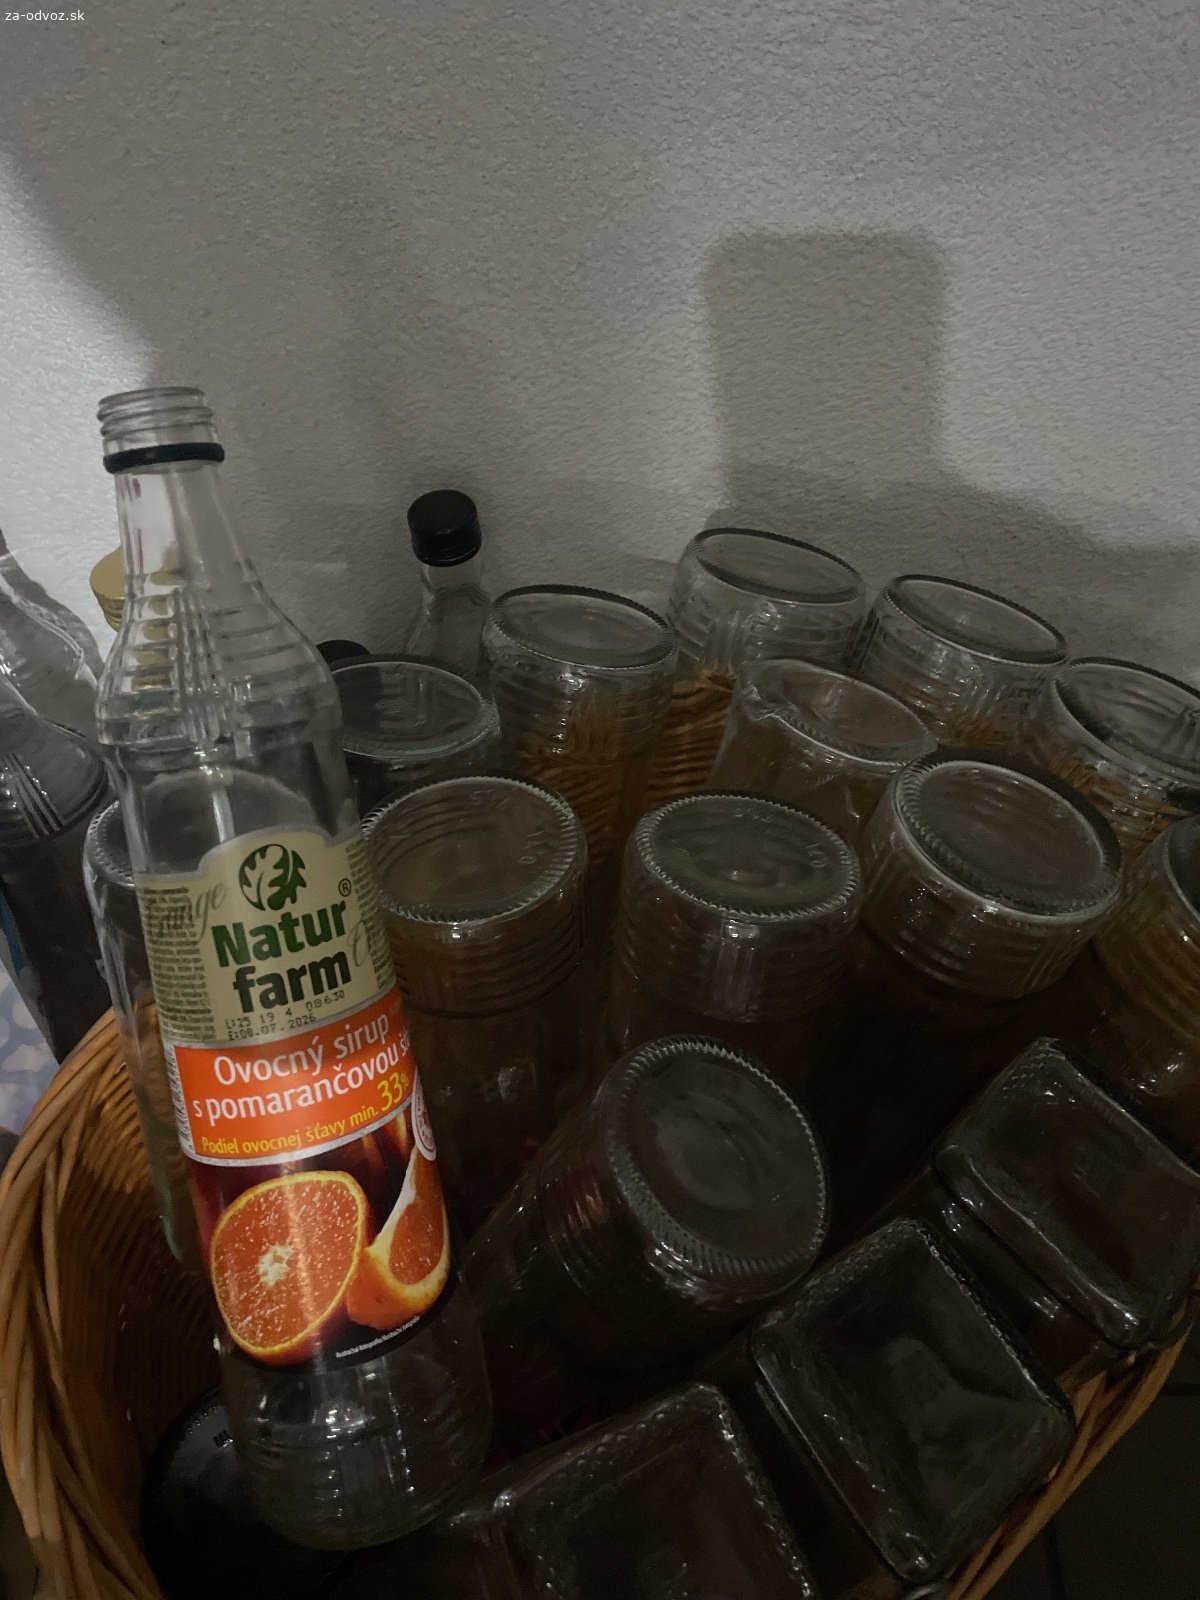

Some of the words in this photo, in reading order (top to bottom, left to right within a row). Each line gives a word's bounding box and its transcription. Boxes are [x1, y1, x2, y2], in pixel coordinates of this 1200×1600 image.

[211, 900, 346, 968] Natur
[233, 951, 351, 1013] farm
[214, 1036, 324, 1086] Ovocný
[336, 1014, 389, 1060] sirup
[193, 1099, 203, 1118] s
[205, 1042, 399, 1127] pomarančovou
[202, 1136, 239, 1155] Podiel
[244, 1130, 302, 1154] ovocnej
[306, 1118, 346, 1141] šťavy
[350, 1105, 379, 1127] min.
